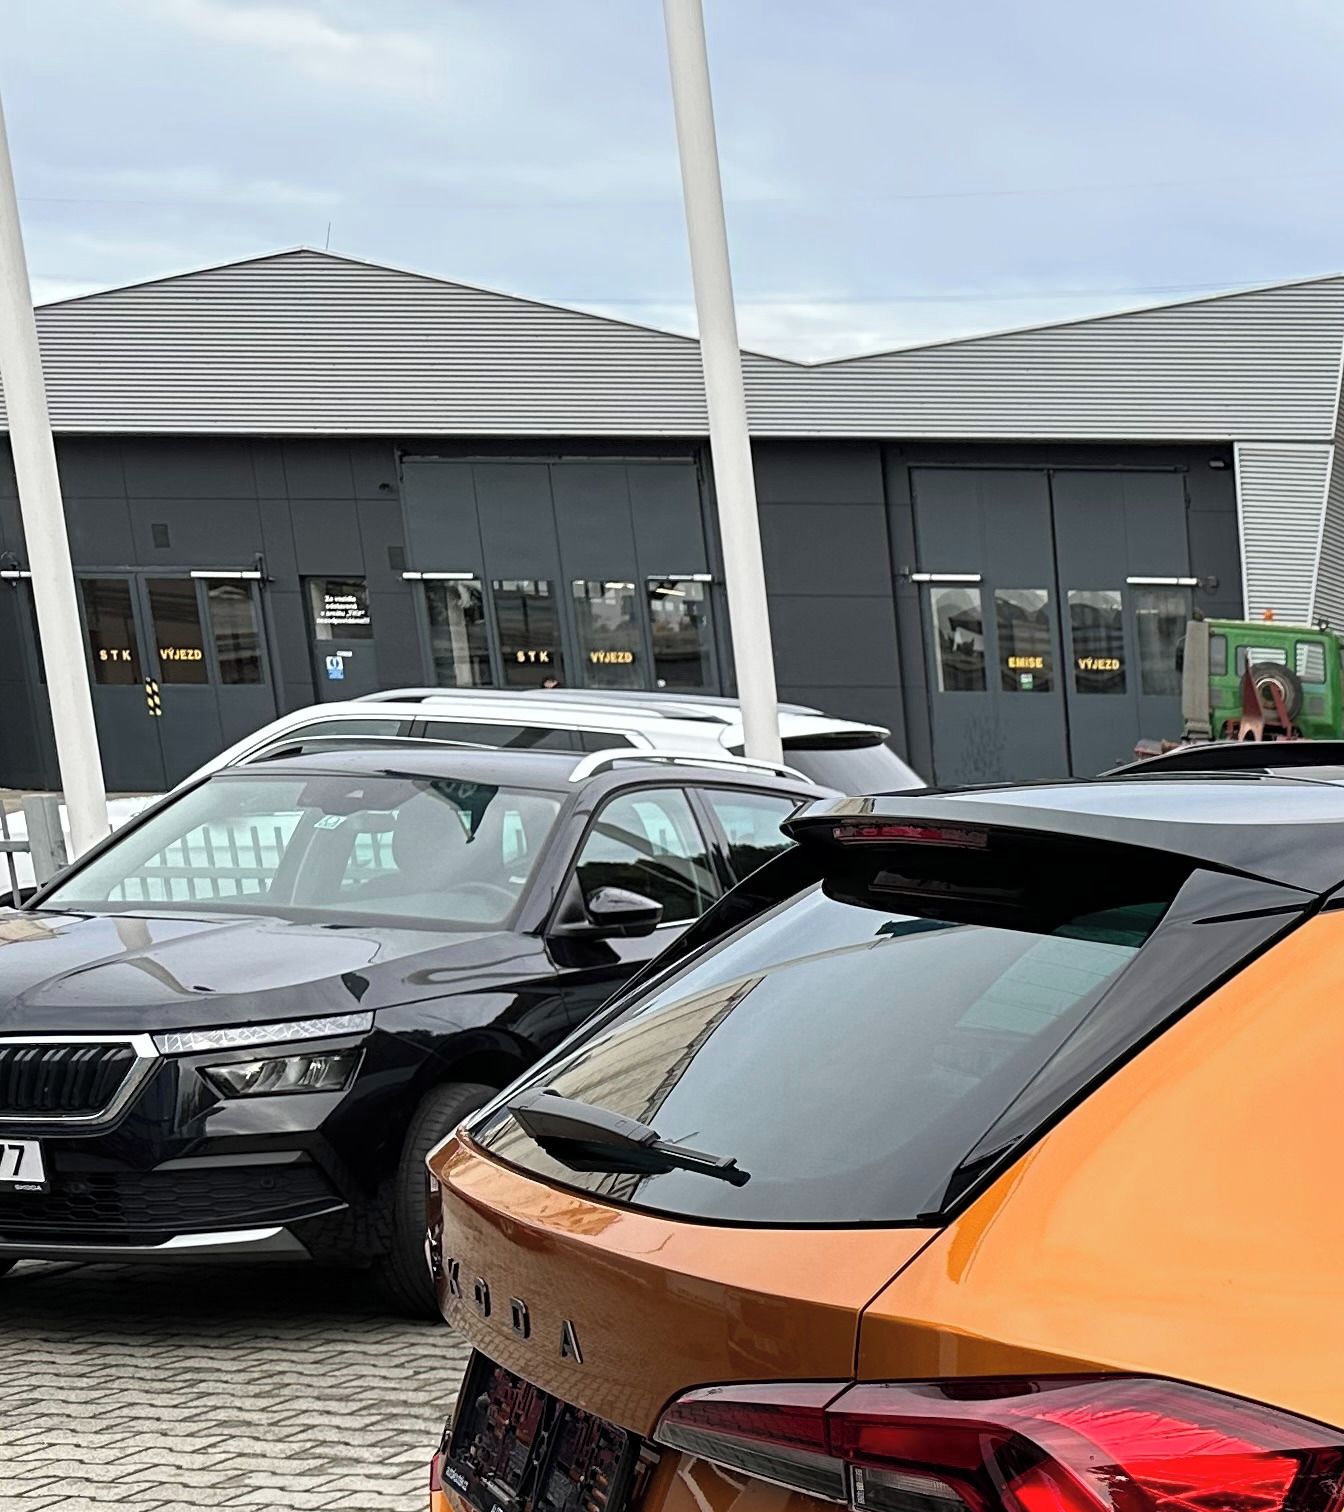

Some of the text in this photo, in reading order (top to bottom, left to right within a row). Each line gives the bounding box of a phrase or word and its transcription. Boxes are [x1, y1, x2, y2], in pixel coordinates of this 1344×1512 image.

[160, 647, 202, 660] VÝJEZD
[590, 650, 633, 664] VÝJEZD
[1078, 656, 1120, 670] VÝJEZD
[447, 1257, 583, 1364] KODA
